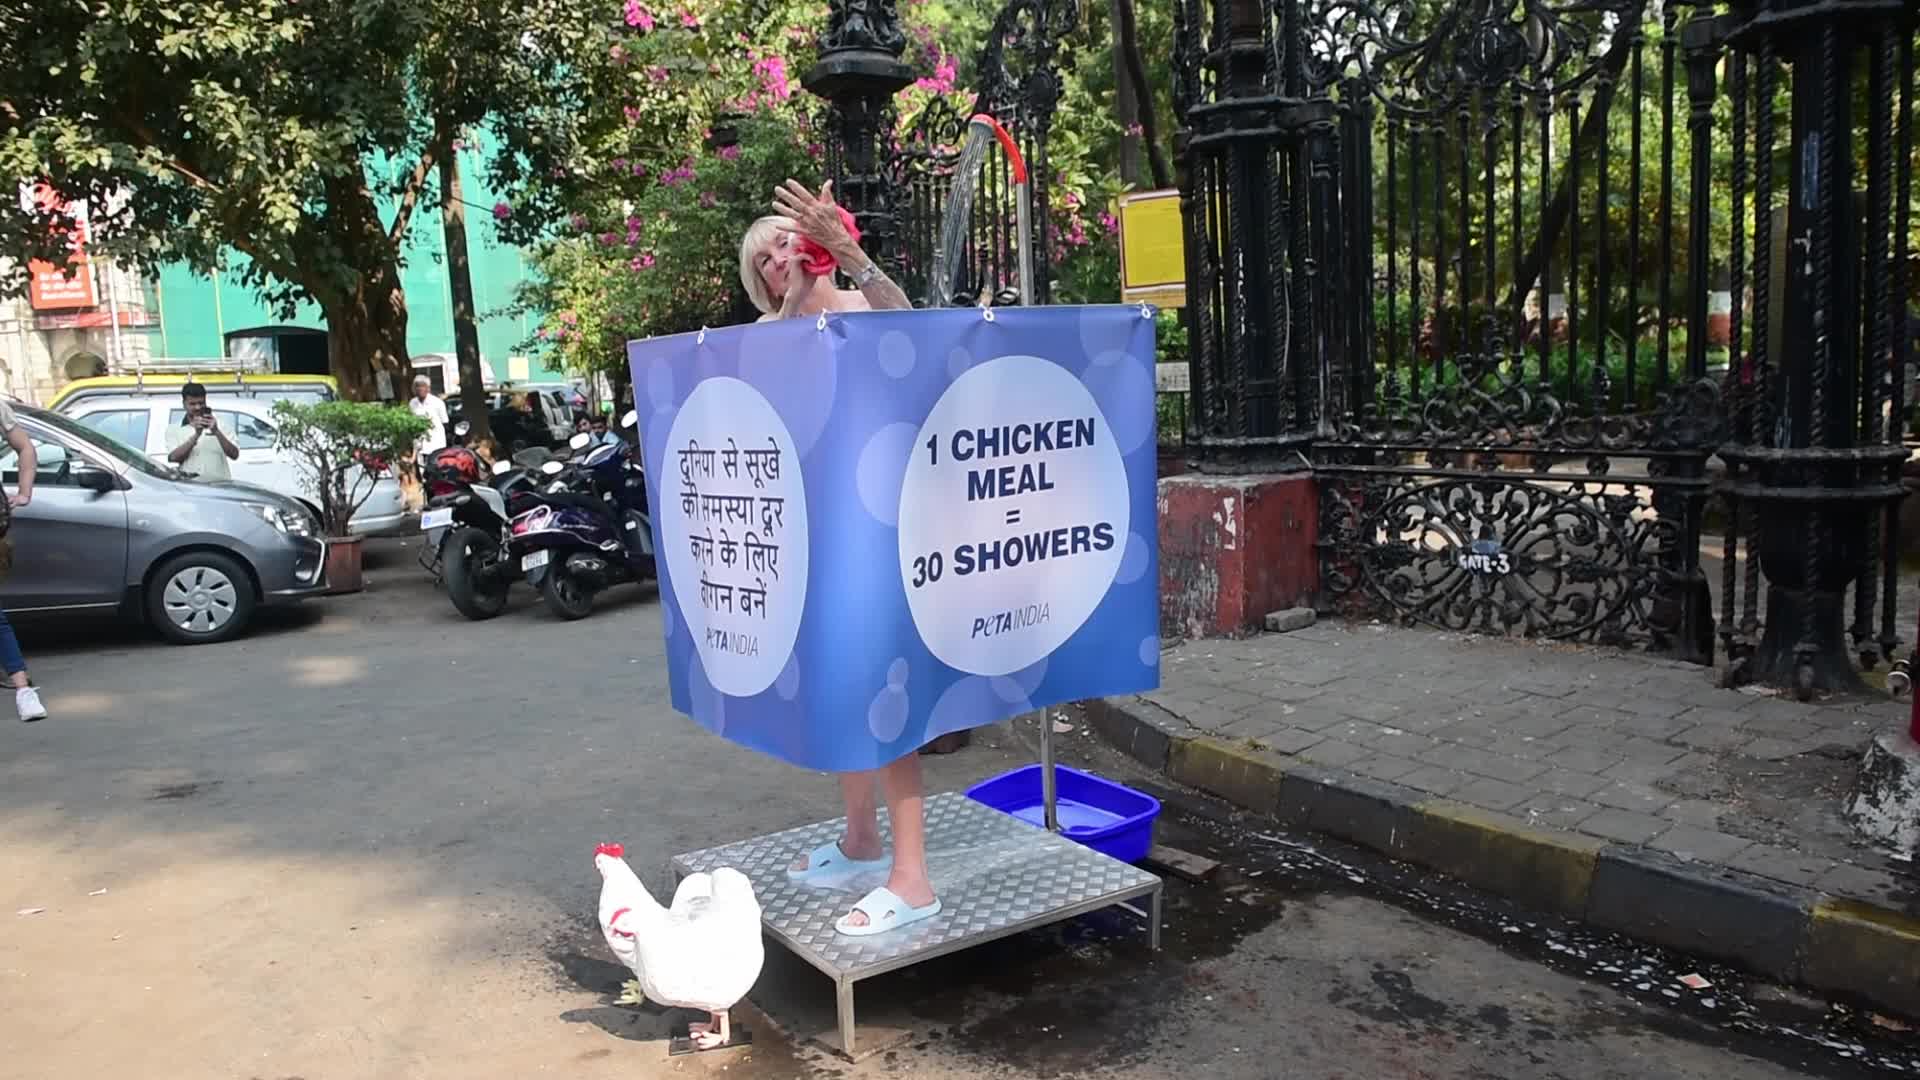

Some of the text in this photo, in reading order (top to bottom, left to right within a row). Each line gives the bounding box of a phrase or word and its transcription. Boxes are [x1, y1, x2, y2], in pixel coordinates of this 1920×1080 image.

[677, 436, 781, 489] दुनिया से सूखे
[926, 417, 1096, 466] 1 CHICKEN
[967, 461, 1055, 502] MEAL
[680, 482, 785, 538] की समस्या दूर
[1006, 509, 1021, 525] =
[718, 528, 739, 569] के
[743, 531, 779, 581] लिए
[912, 522, 1115, 589] 30 SHOWERS
[737, 577, 768, 620] बनें
